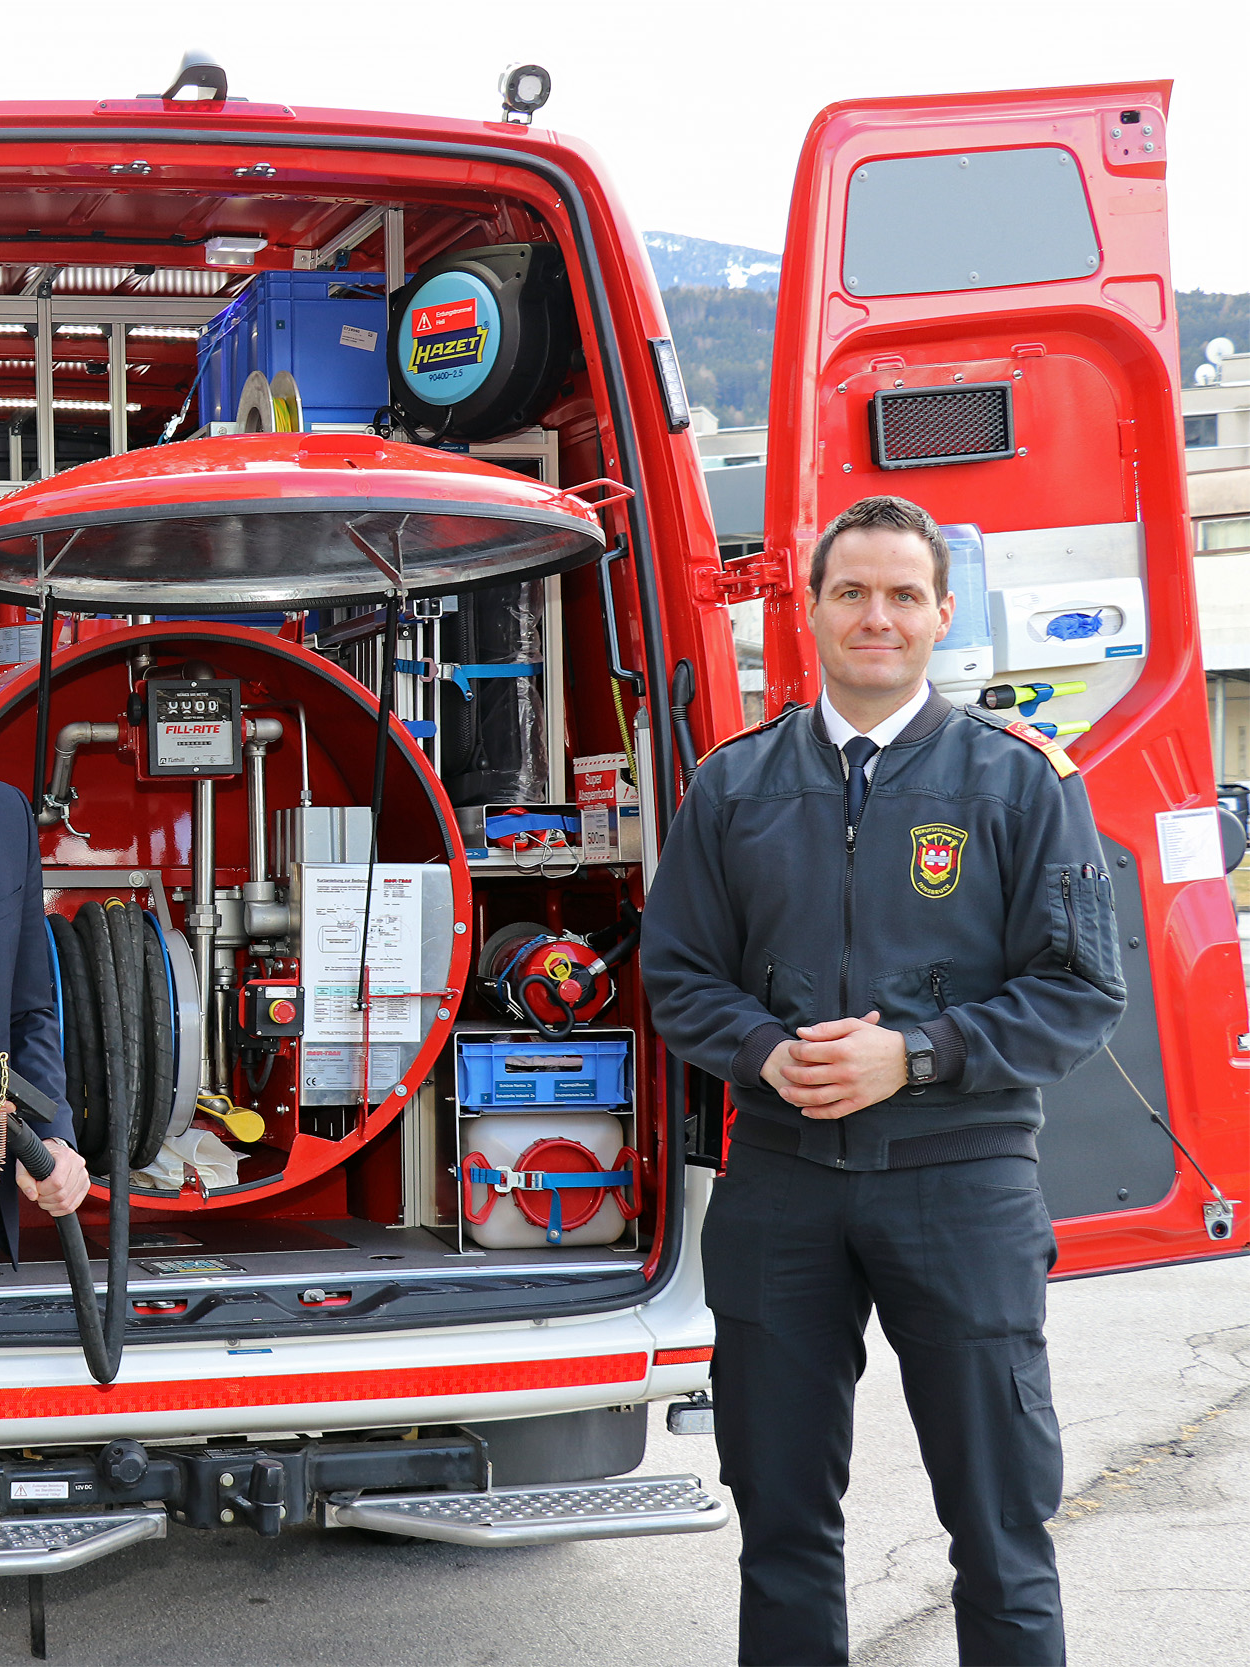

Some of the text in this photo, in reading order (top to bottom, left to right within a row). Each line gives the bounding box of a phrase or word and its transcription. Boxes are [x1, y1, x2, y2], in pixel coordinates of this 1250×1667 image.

[415, 337, 480, 365] HAZET
[166, 724, 221, 734] FILL-RITE
[585, 774, 603, 787] Super
[917, 881, 951, 895] INNSBRUCK
